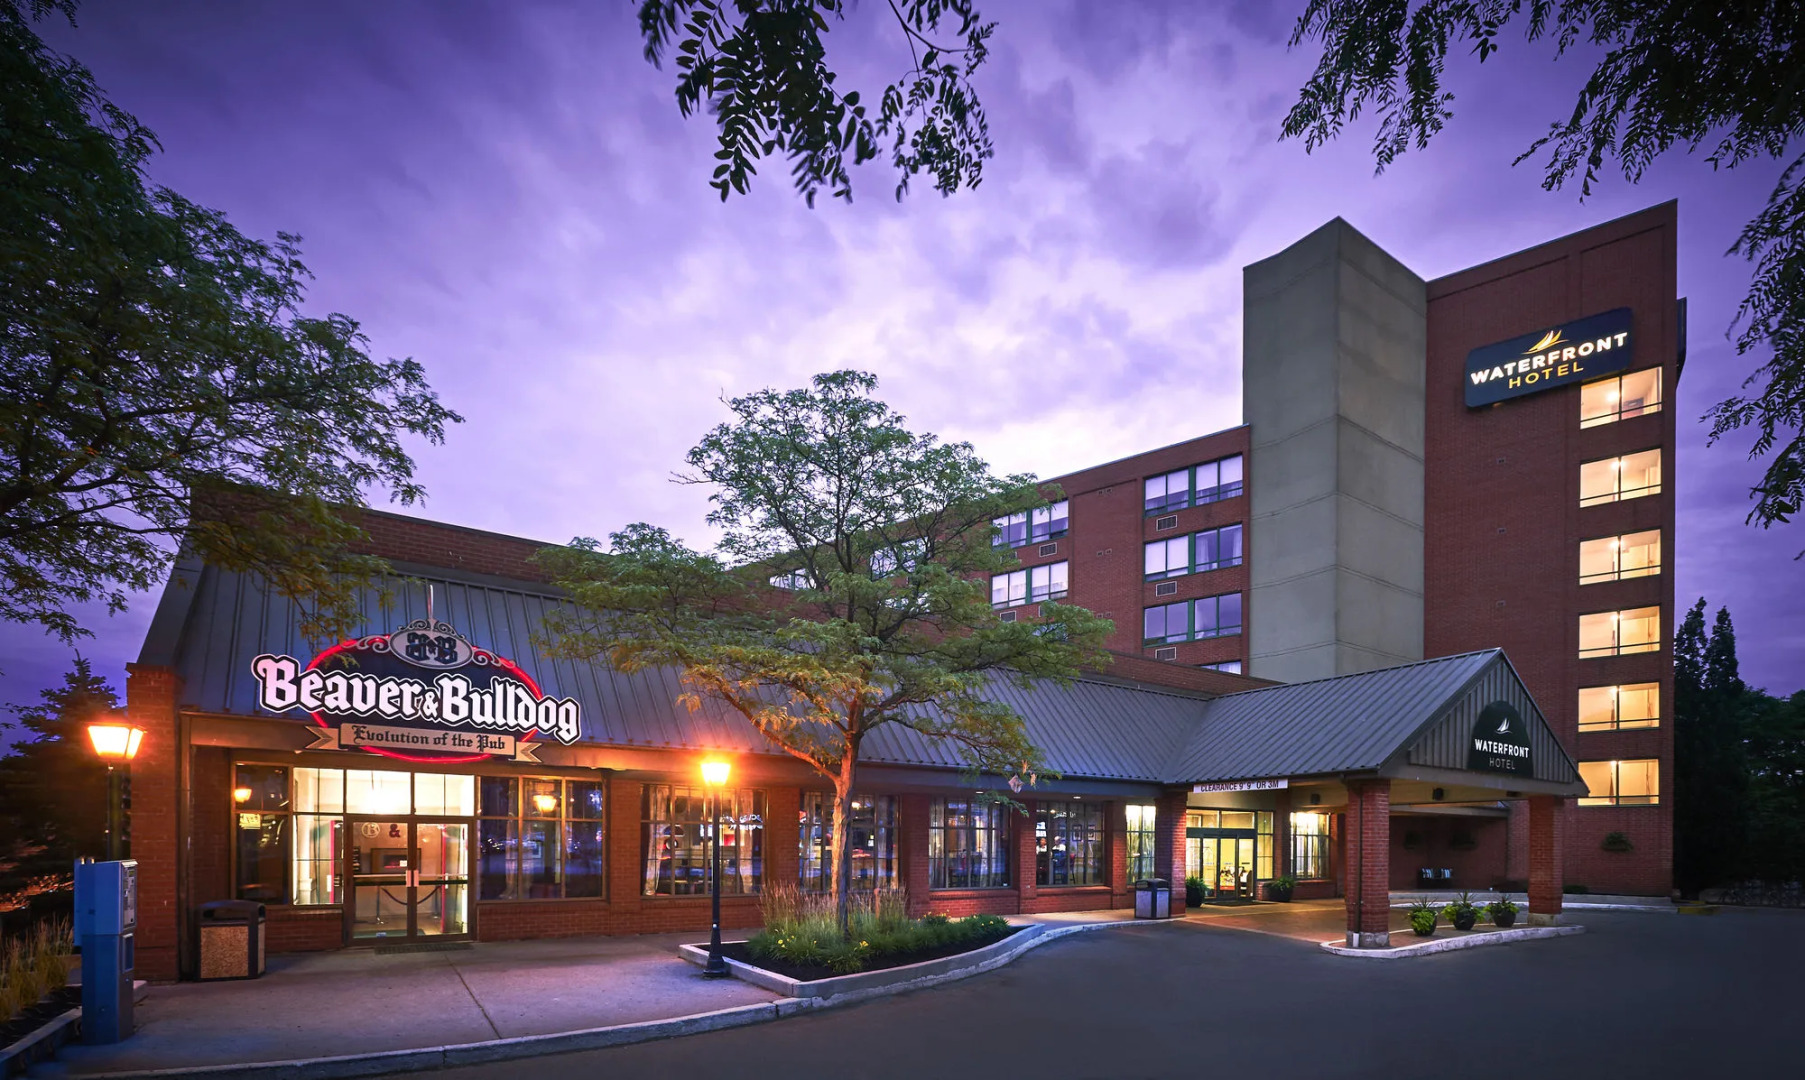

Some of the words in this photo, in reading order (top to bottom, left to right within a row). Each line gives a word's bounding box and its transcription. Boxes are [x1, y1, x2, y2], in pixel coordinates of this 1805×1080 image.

[1470, 332, 1627, 385] WATERFRONT
[1508, 362, 1584, 389] HOTEL
[254, 655, 424, 718] Beaver
[422, 691, 439, 718] &
[437, 675, 580, 743] Bulldog
[351, 725, 430, 745] Evolution
[433, 732, 449, 746] of
[452, 733, 473, 748] the
[476, 734, 506, 752] Pub
[1474, 738, 1530, 758] WATERFRONT
[1489, 758, 1516, 770] HOTEL
[1200, 783, 1238, 792] CLEARANCE
[1256, 780, 1267, 789] OR
[1268, 780, 1279, 789] 3M
